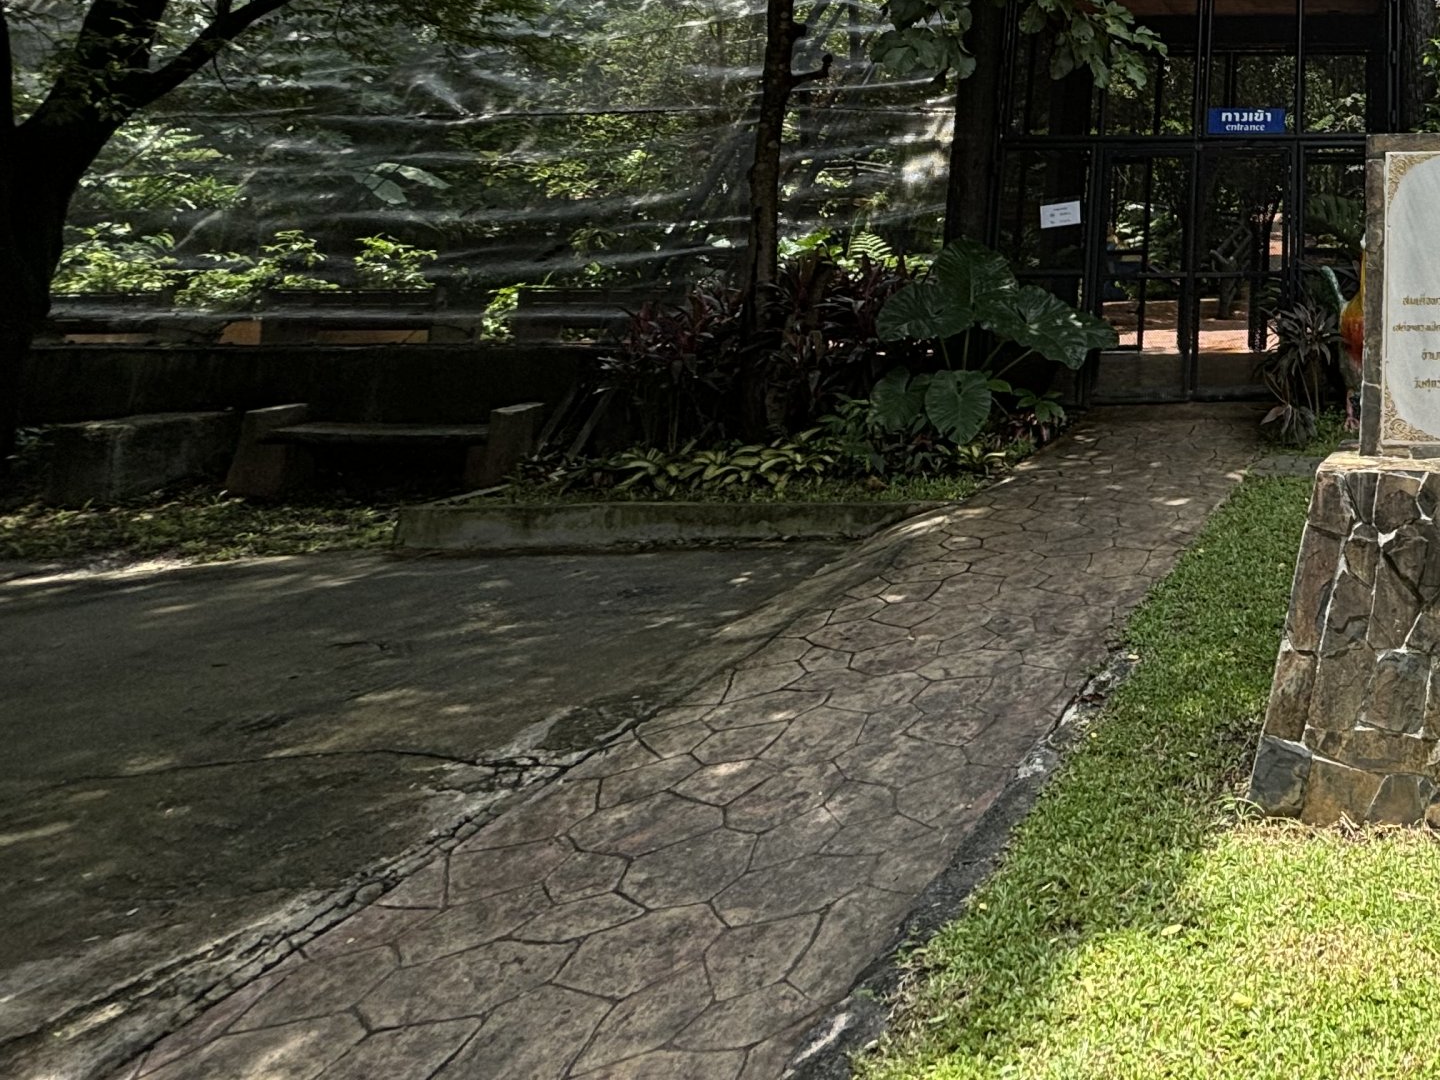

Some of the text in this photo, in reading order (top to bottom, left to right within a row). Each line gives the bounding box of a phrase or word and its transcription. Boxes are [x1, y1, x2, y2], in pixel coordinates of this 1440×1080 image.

[1221, 109, 1272, 122] ทางเข้า
[1225, 123, 1266, 131] entrance
